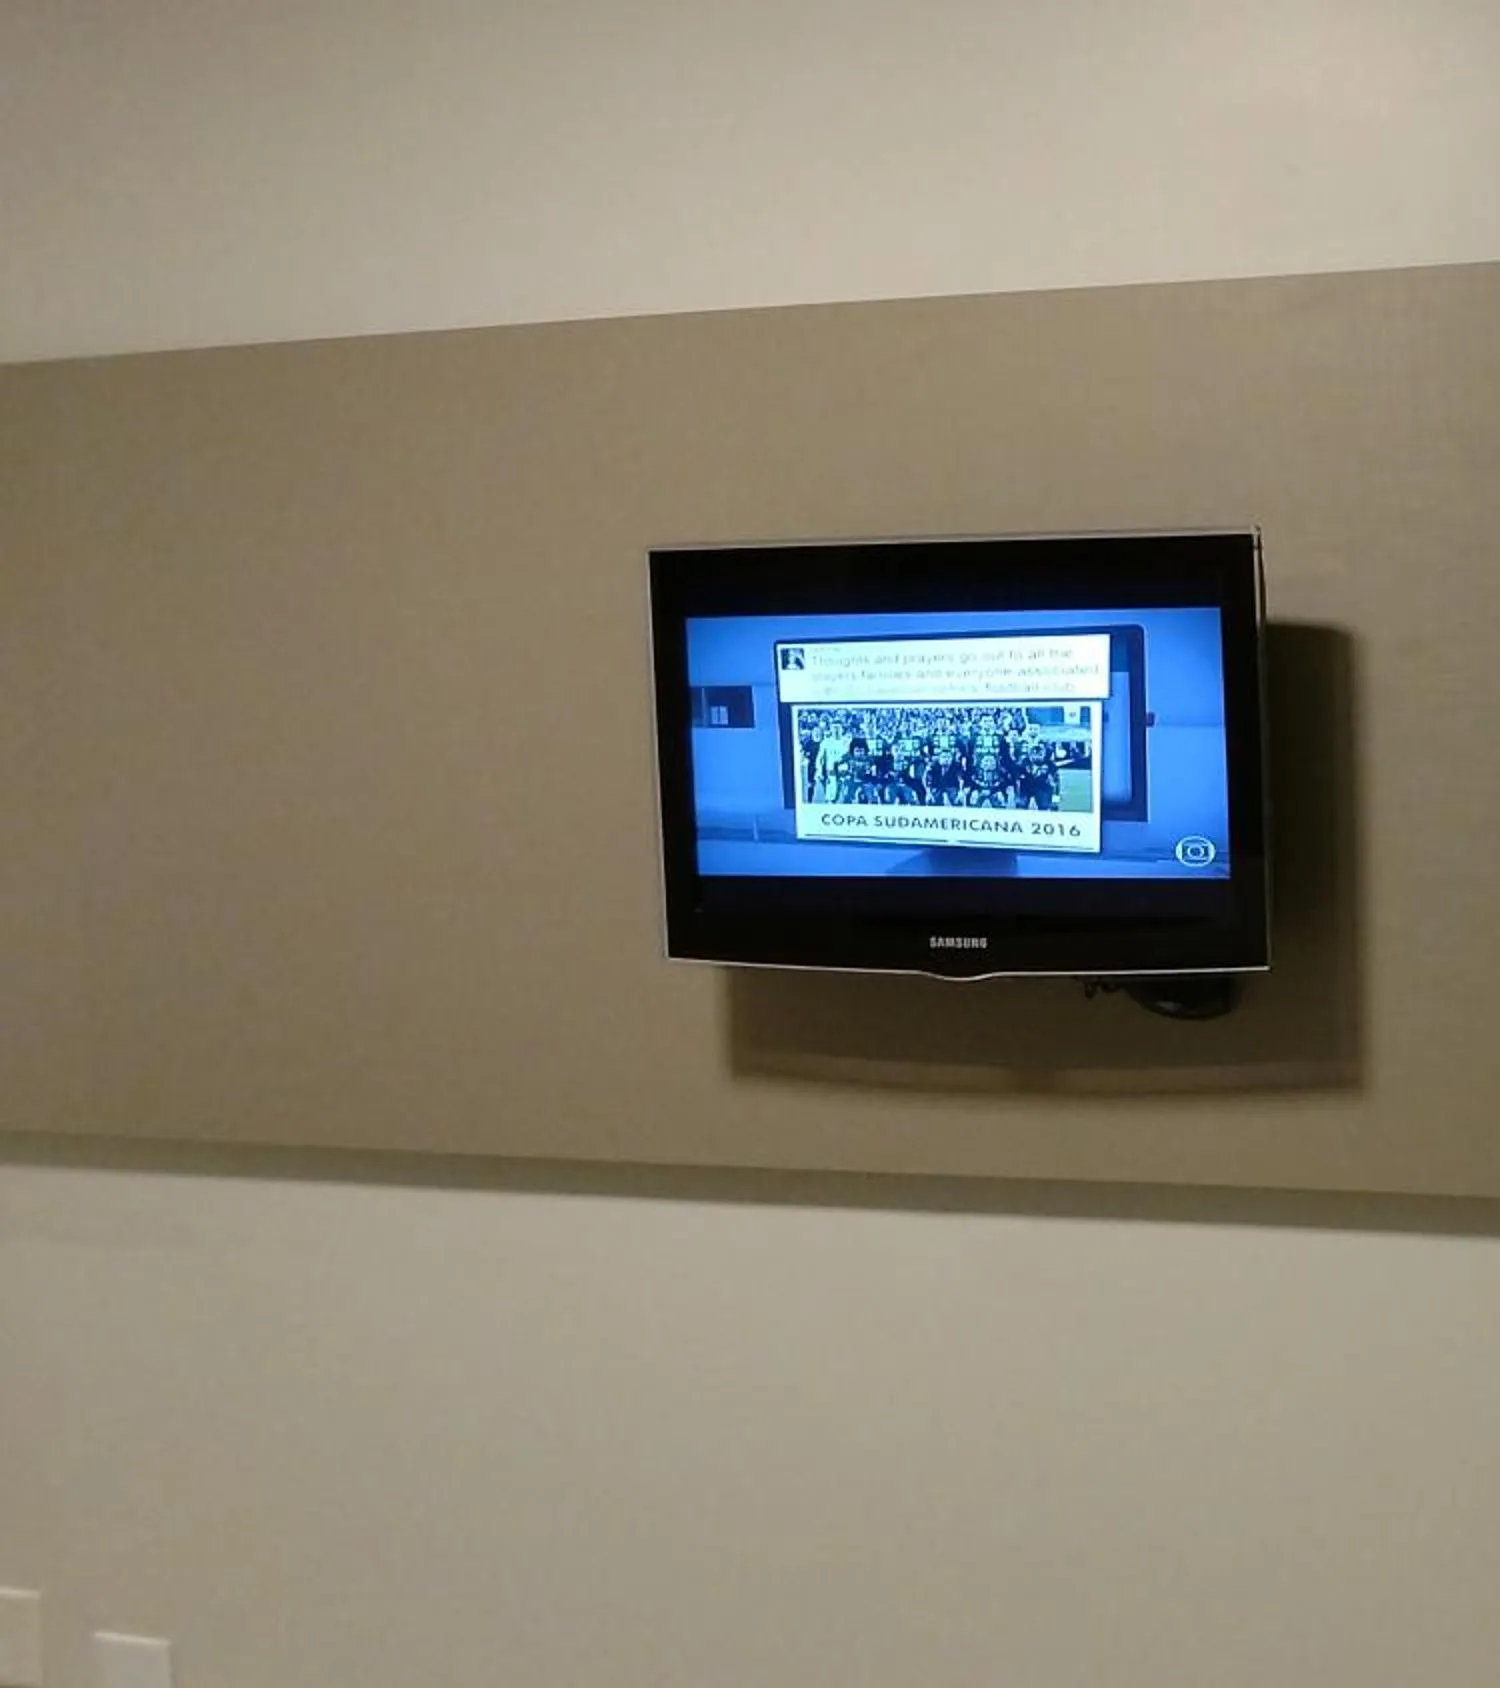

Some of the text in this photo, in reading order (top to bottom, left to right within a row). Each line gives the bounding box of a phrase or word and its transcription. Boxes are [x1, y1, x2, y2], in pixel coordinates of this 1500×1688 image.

[820, 813, 1081, 837] COPA SUDAMERICANA 2016
[928, 936, 988, 949] SAMSUNG
